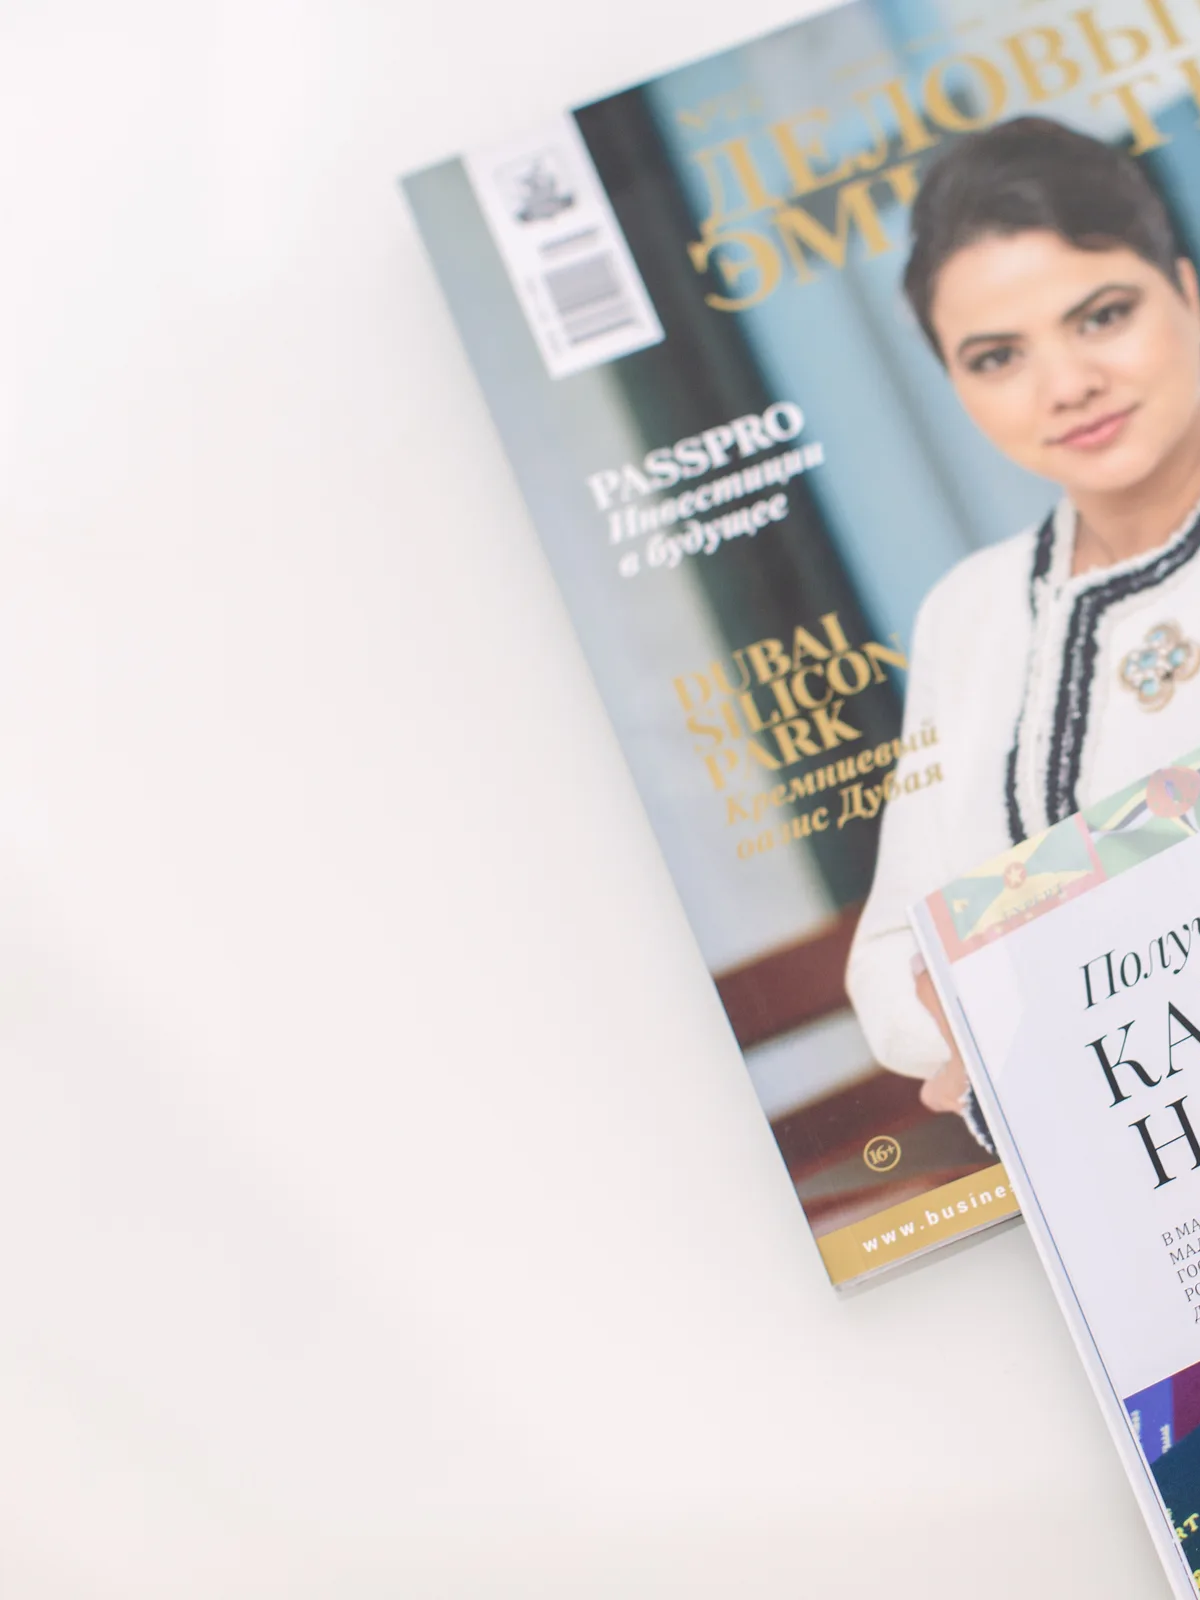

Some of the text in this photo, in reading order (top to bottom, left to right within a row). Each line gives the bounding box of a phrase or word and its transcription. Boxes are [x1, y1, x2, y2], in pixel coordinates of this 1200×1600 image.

[585, 400, 805, 512] PASSPRO
[673, 611, 851, 713] DUBAI
[686, 632, 909, 746] SILICON
[703, 700, 863, 791] PARK
[837, 761, 944, 831] Дубая
[868, 1142, 896, 1166] 16+
[1161, 1231, 1173, 1246] В
